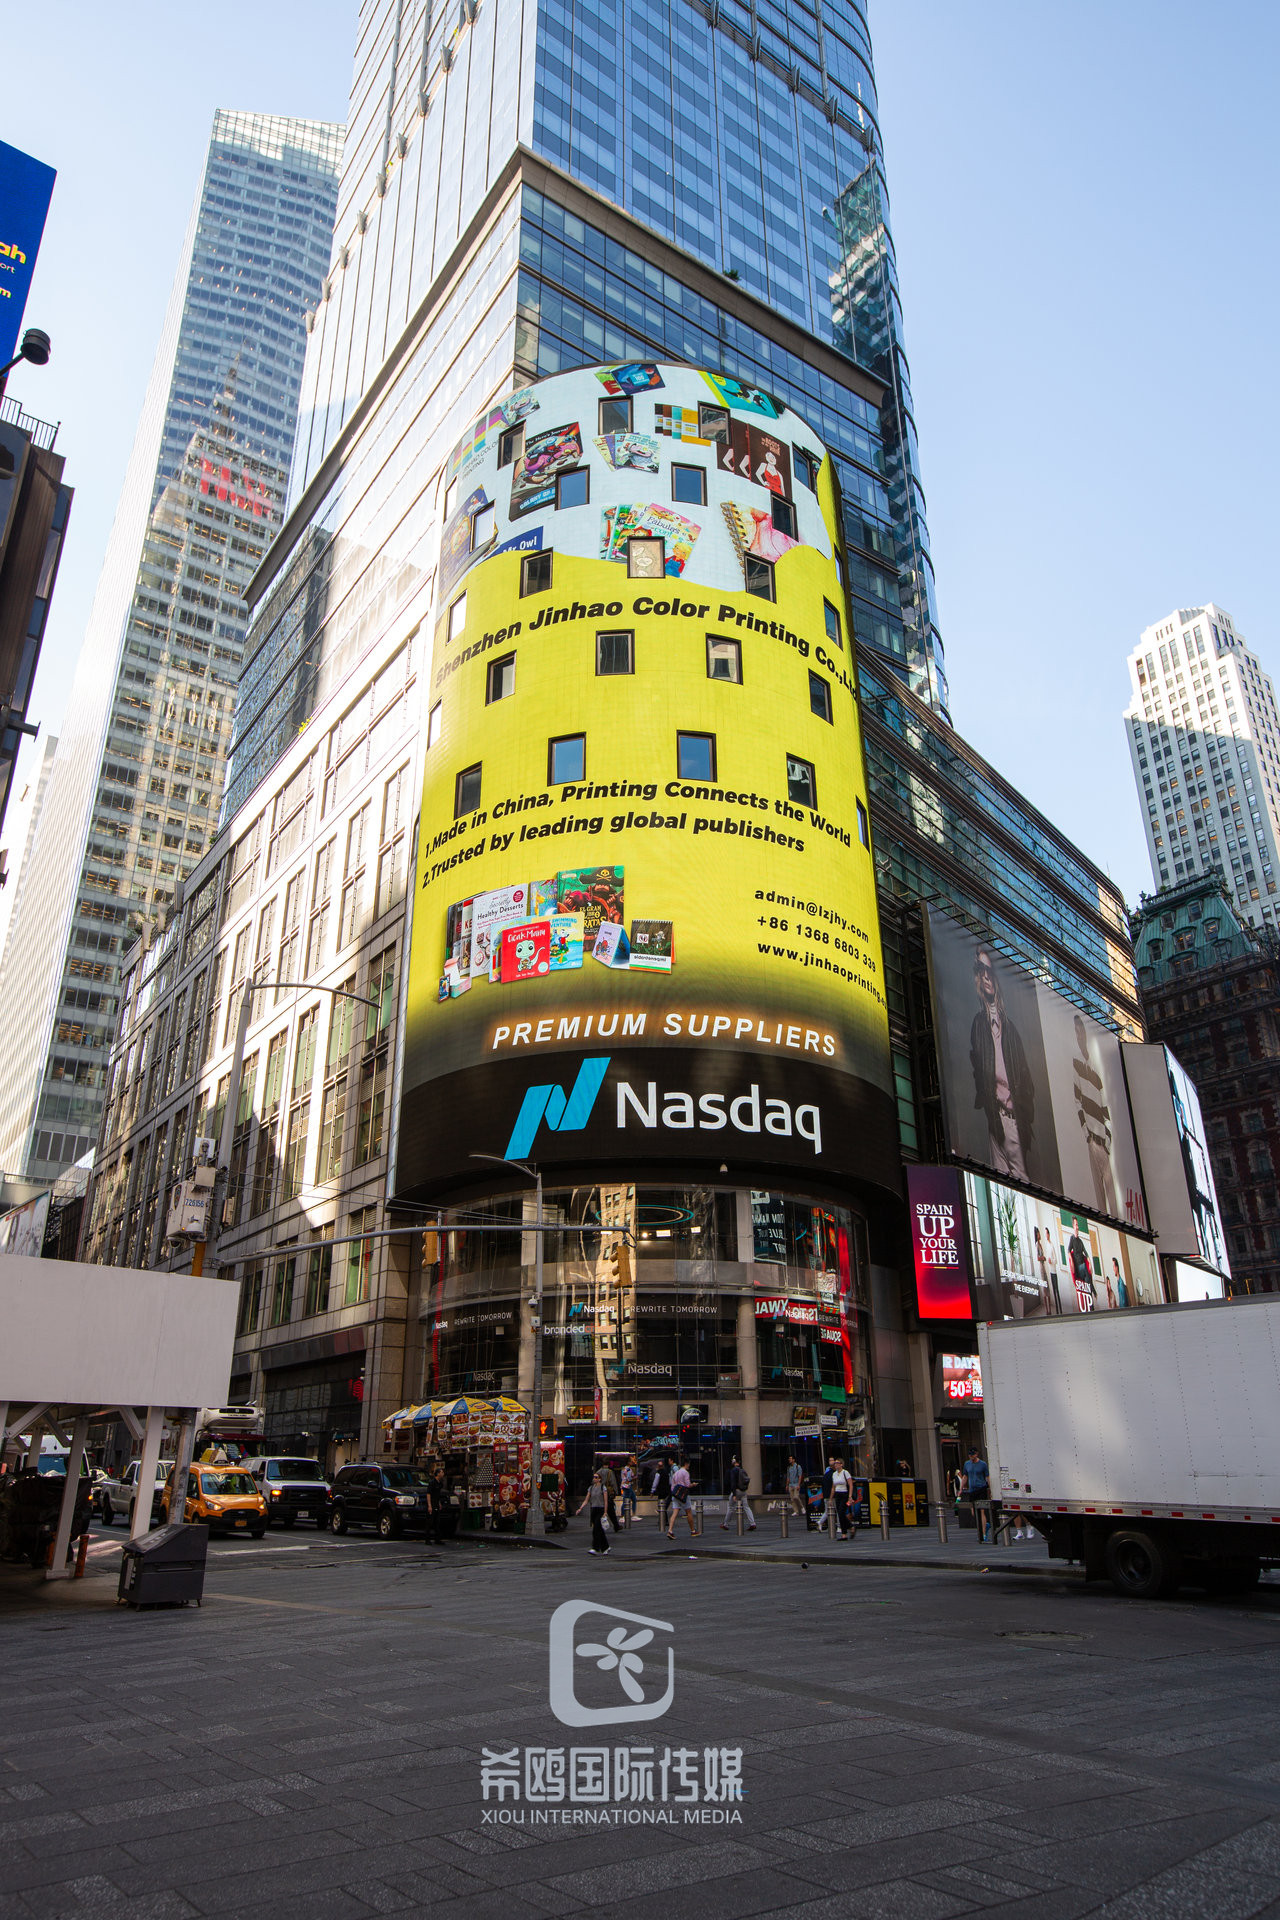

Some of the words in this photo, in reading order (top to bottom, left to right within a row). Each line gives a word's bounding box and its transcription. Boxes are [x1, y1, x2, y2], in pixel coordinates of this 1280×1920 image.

[519, 536, 538, 551] Owl
[436, 621, 522, 689] Shenzhen
[529, 600, 623, 631] Jinhao
[632, 597, 709, 619] Color
[717, 604, 810, 658] Printing
[425, 821, 467, 859] 1.Made
[471, 811, 488, 830] in
[492, 793, 554, 820] China,
[561, 780, 657, 802] Printing
[665, 780, 769, 811] Connects
[774, 799, 804, 822] the
[809, 811, 851, 848] World
[422, 838, 486, 890] 2.Trusted
[490, 831, 515, 852] by
[519, 811, 602, 843] leading
[610, 812, 686, 834] global
[693, 817, 806, 853] publishers
[477, 909, 498, 921] Healthy
[499, 903, 524, 914] Desserts
[754, 889, 869, 943] admin@lzjhy.com
[584, 916, 607, 929] RATAS
[757, 915, 789, 932] +86
[796, 924, 830, 945] 1368
[834, 937, 860, 960] 6803
[492, 1013, 648, 1050] PREMIUM
[663, 1013, 836, 1057] SUPPLIERS
[616, 1081, 823, 1156] Nasdaq
[916, 1203, 953, 1216] SPAIN
[917, 1215, 955, 1238] UP
[919, 1237, 958, 1250] YOUR
[920, 1249, 959, 1265] LIFE
[1075, 1280, 1092, 1294] SPAIN
[584, 1304, 615, 1314] Nasdaq
[630, 1305, 667, 1313] REWRITE
[671, 1305, 718, 1314] TOMORROW
[1077, 1291, 1093, 1313] UP
[454, 1316, 475, 1326] REWRITE
[477, 1311, 513, 1322] TOMORROW
[628, 1363, 672, 1377] Nasdaq
